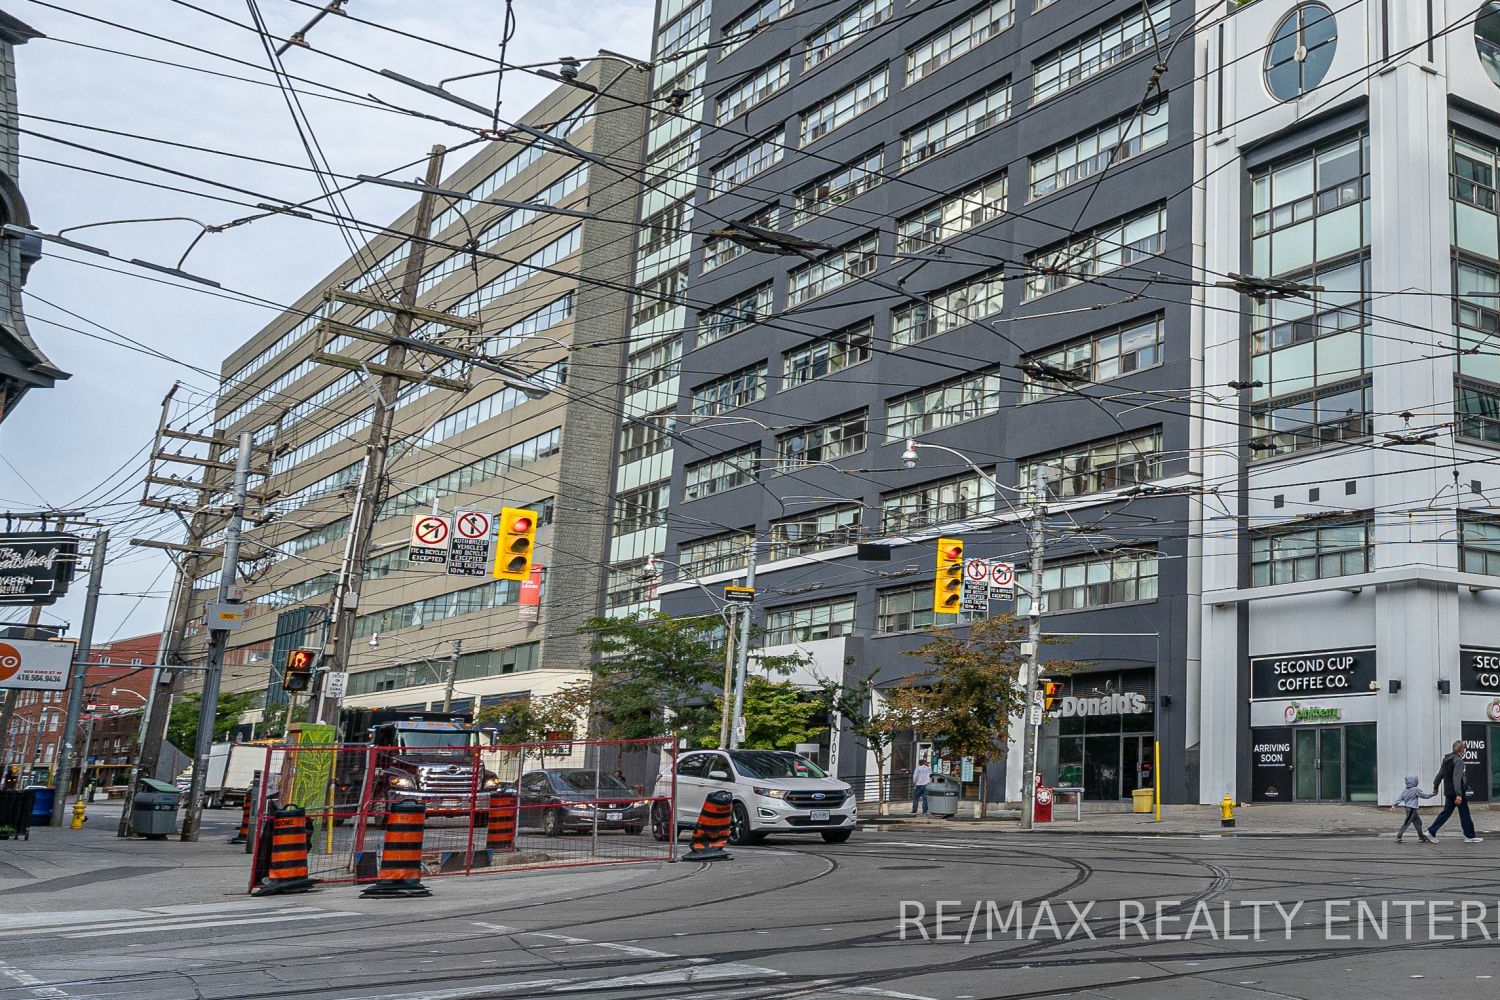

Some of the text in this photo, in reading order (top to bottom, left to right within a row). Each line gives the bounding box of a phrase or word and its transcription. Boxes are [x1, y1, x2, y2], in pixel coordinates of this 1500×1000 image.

[412, 555, 444, 563] EXCEPTED
[1274, 656, 1353, 674] SECOND CUP
[1277, 674, 1348, 691] COFFEE CO.
[1048, 692, 1146, 717] cDonald's
[1253, 743, 1290, 752] ARRIVING
[1463, 740, 1485, 749] VING
[1260, 753, 1283, 762] SOON
